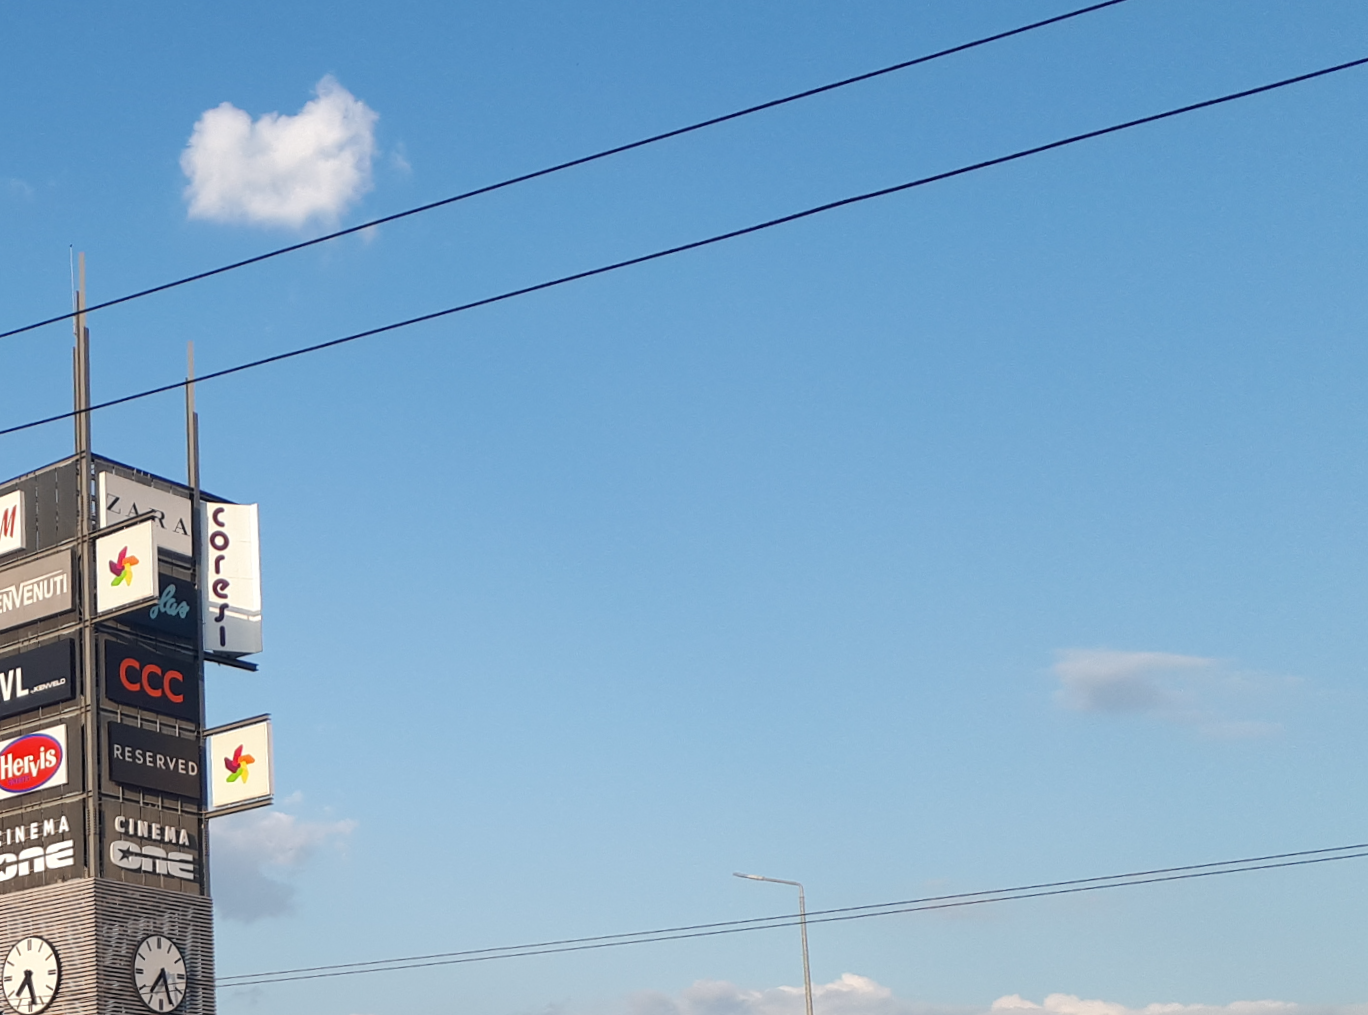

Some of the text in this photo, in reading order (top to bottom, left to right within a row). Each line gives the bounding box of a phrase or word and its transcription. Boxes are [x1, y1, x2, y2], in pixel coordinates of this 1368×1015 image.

[107, 493, 190, 537] ZARA
[119, 657, 184, 703] CCC
[0, 746, 57, 780] Hervis
[113, 744, 198, 777] RESERVED
[114, 816, 190, 846] CINEMA
